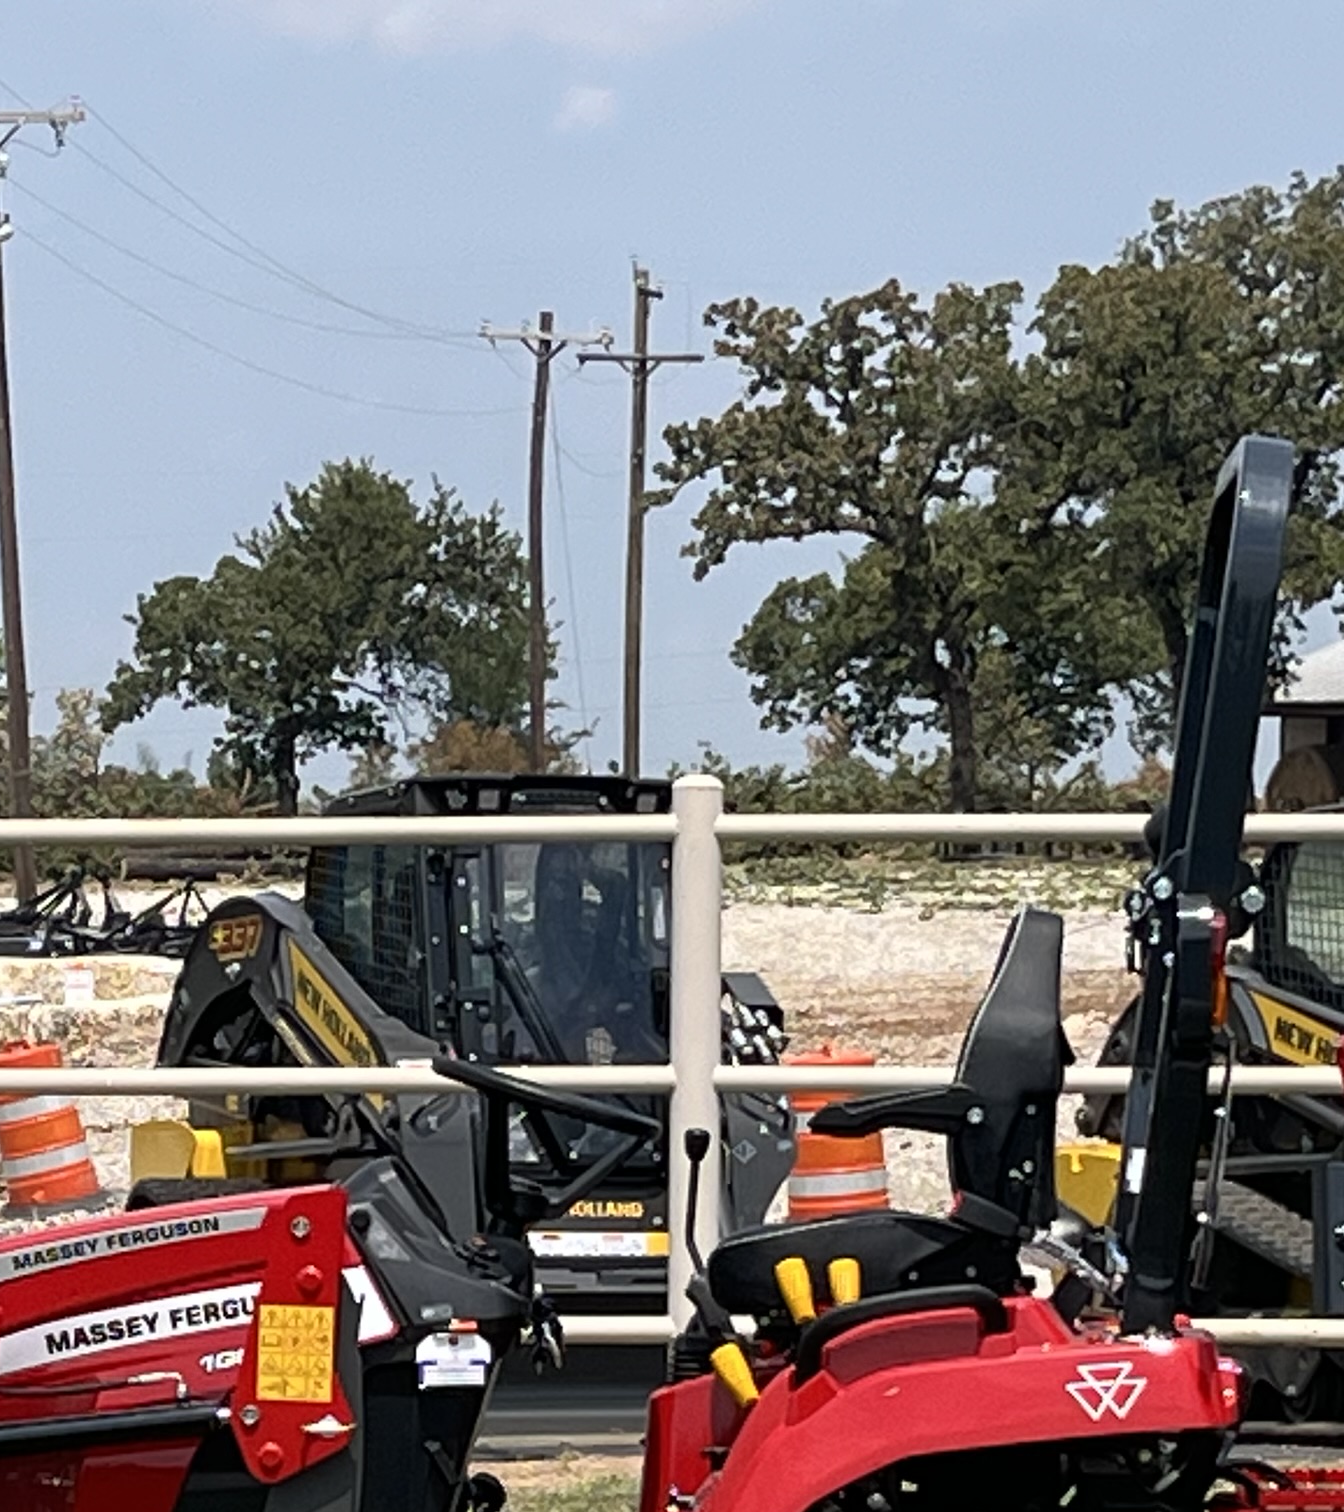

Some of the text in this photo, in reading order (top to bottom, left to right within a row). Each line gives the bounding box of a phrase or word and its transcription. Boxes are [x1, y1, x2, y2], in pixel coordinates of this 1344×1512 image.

[1274, 1016, 1314, 1057] NEW
[12, 1215, 220, 1271] MASSEY FERGUSON
[44, 1311, 159, 1355] MASSEY
